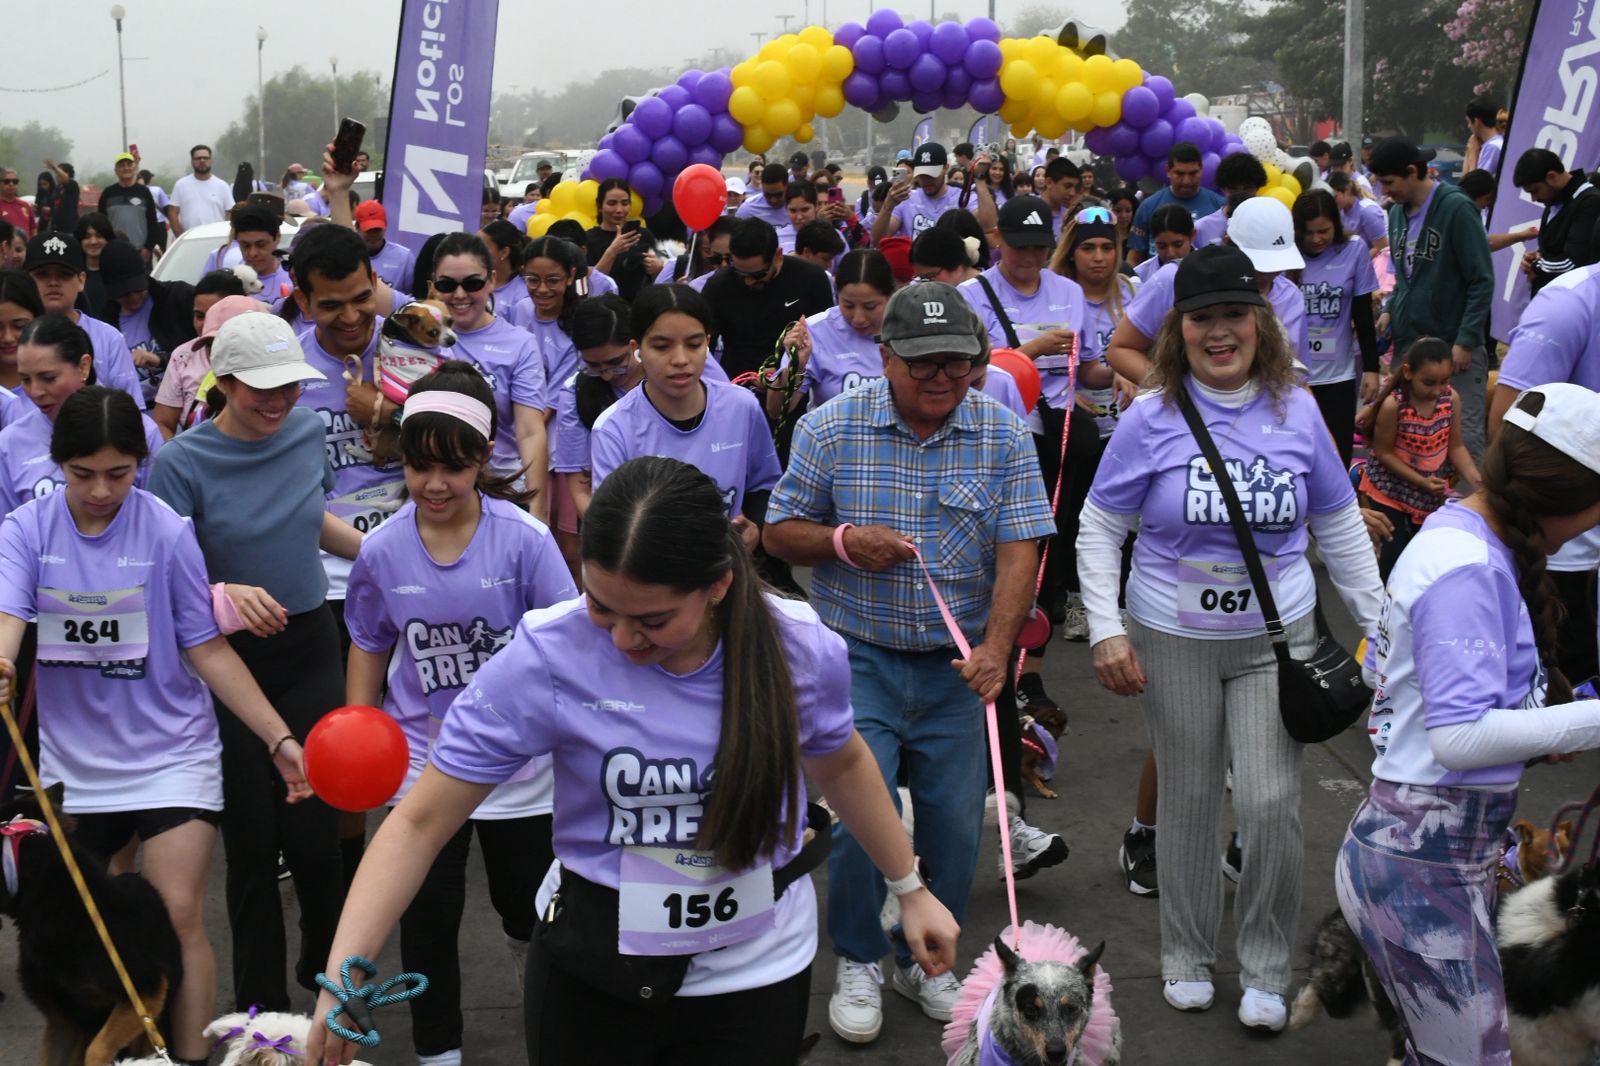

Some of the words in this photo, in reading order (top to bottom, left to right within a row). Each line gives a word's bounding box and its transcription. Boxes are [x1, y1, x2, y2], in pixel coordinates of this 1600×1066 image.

[64, 619, 120, 645] 264
[407, 622, 470, 661] CAN
[605, 753, 700, 809] CAN
[663, 886, 739, 929] 156
